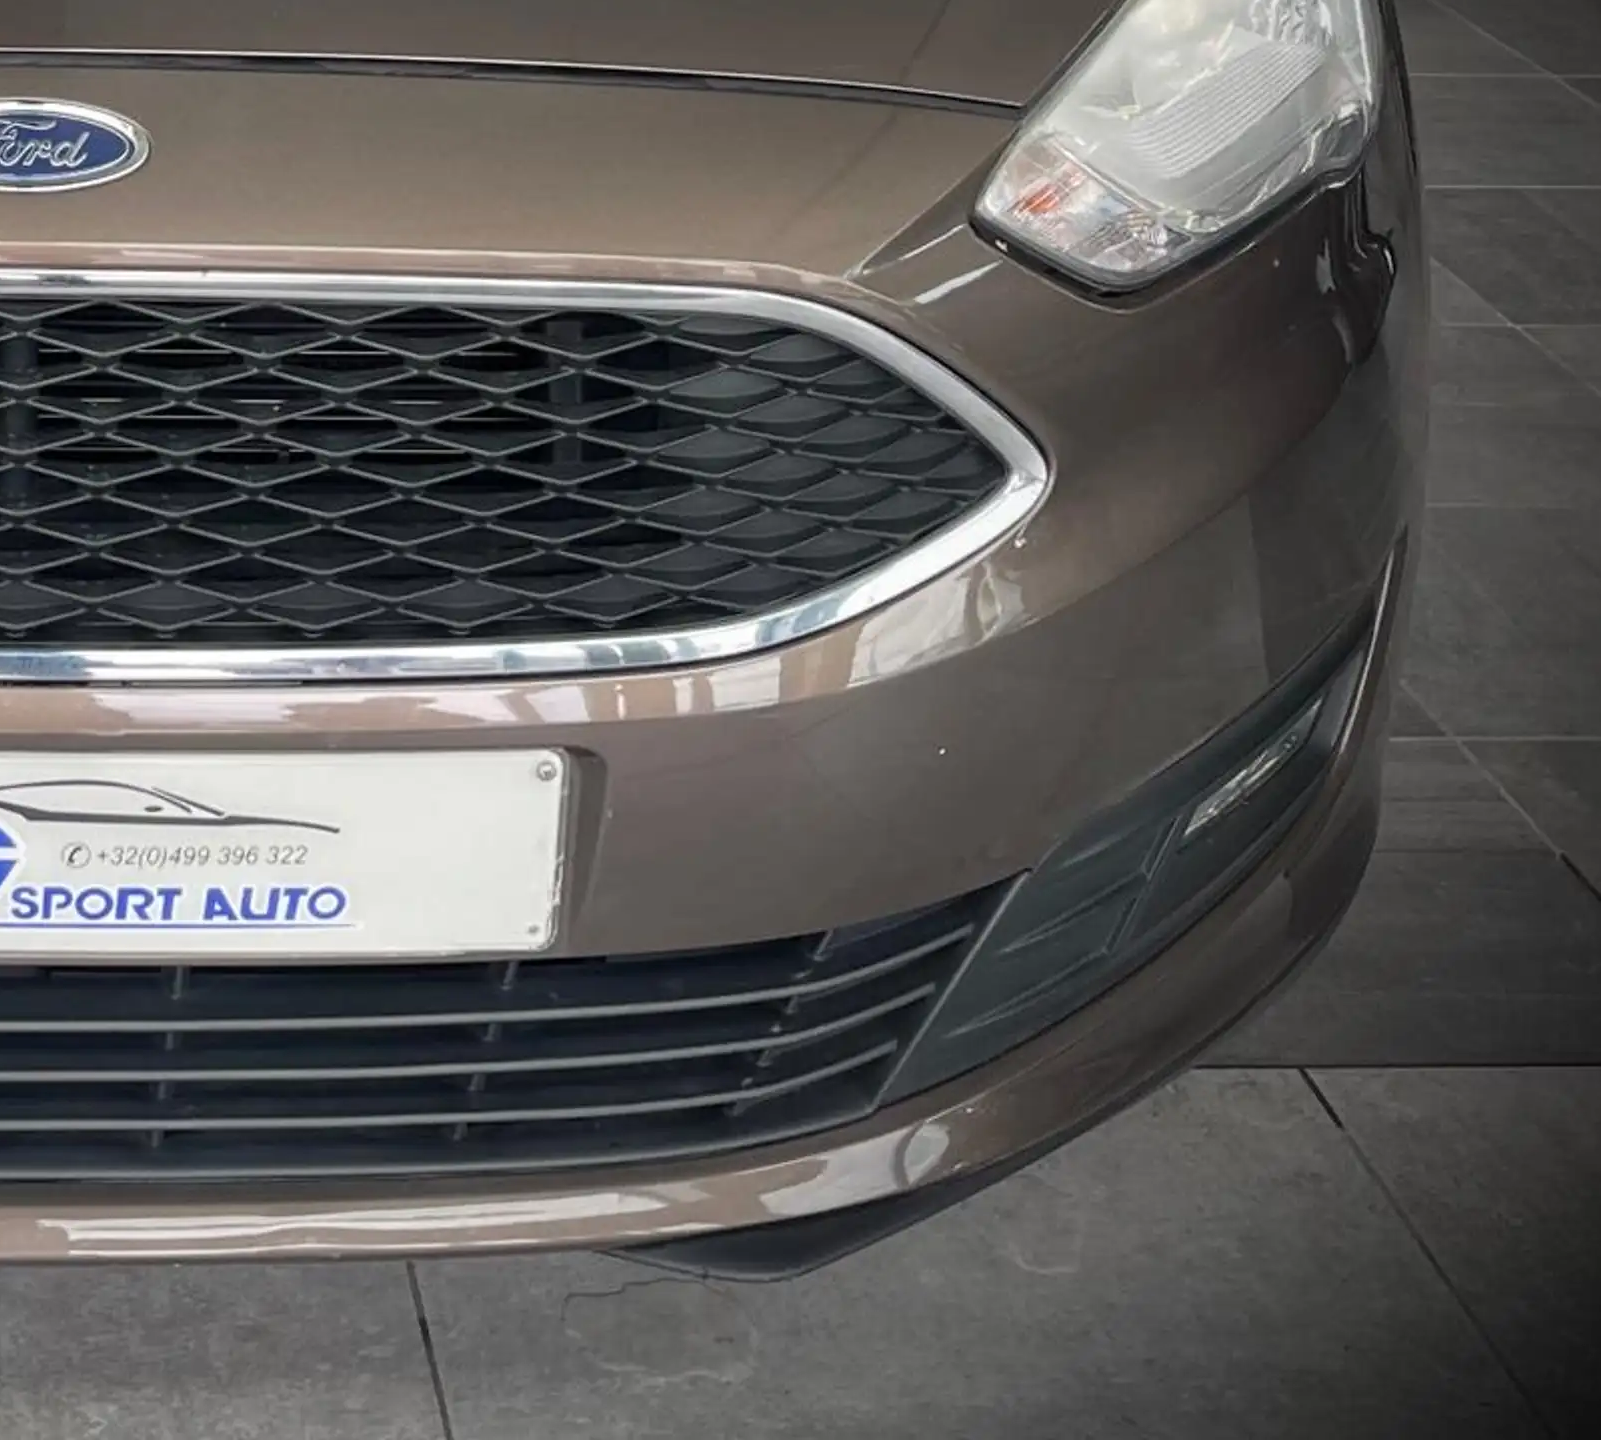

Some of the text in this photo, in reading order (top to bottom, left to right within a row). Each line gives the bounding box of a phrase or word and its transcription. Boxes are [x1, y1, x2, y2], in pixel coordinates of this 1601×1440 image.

[96, 844, 310, 869] +32(0)499 396 322
[10, 886, 347, 921] SPORT AUTO
